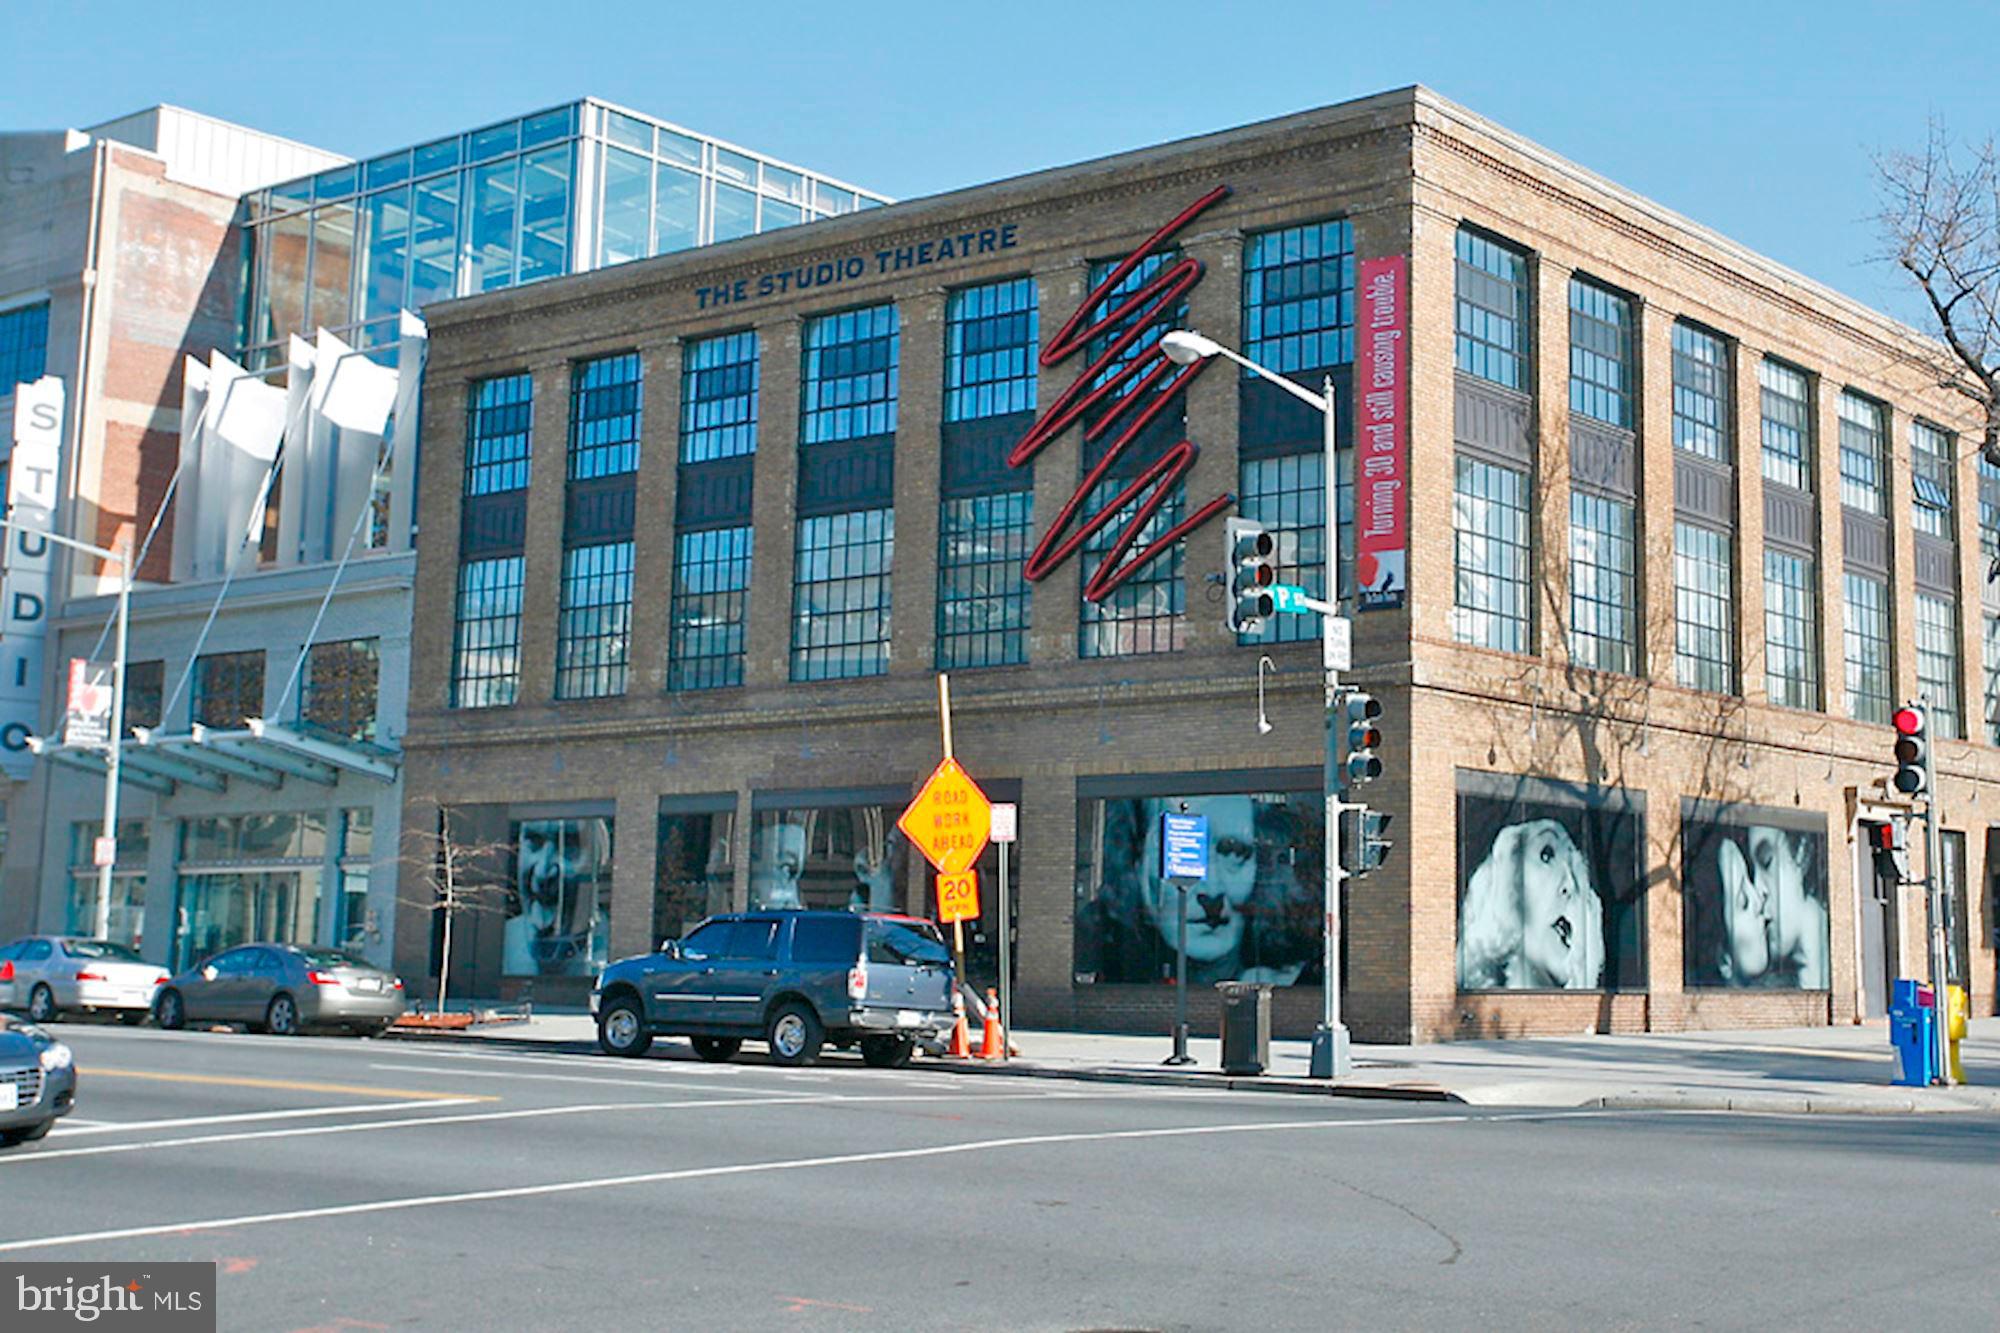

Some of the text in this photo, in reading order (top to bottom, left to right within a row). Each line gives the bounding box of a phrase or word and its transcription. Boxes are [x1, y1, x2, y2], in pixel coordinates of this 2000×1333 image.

[695, 224, 1018, 309] THE STUDIO THEATRE
[1364, 269, 1401, 538] Turning 30 and still causing trouble.
[933, 790, 968, 805] ROAD
[934, 812, 969, 829] WORK
[933, 832, 973, 851] AHEAD
[944, 878, 971, 901] 20
